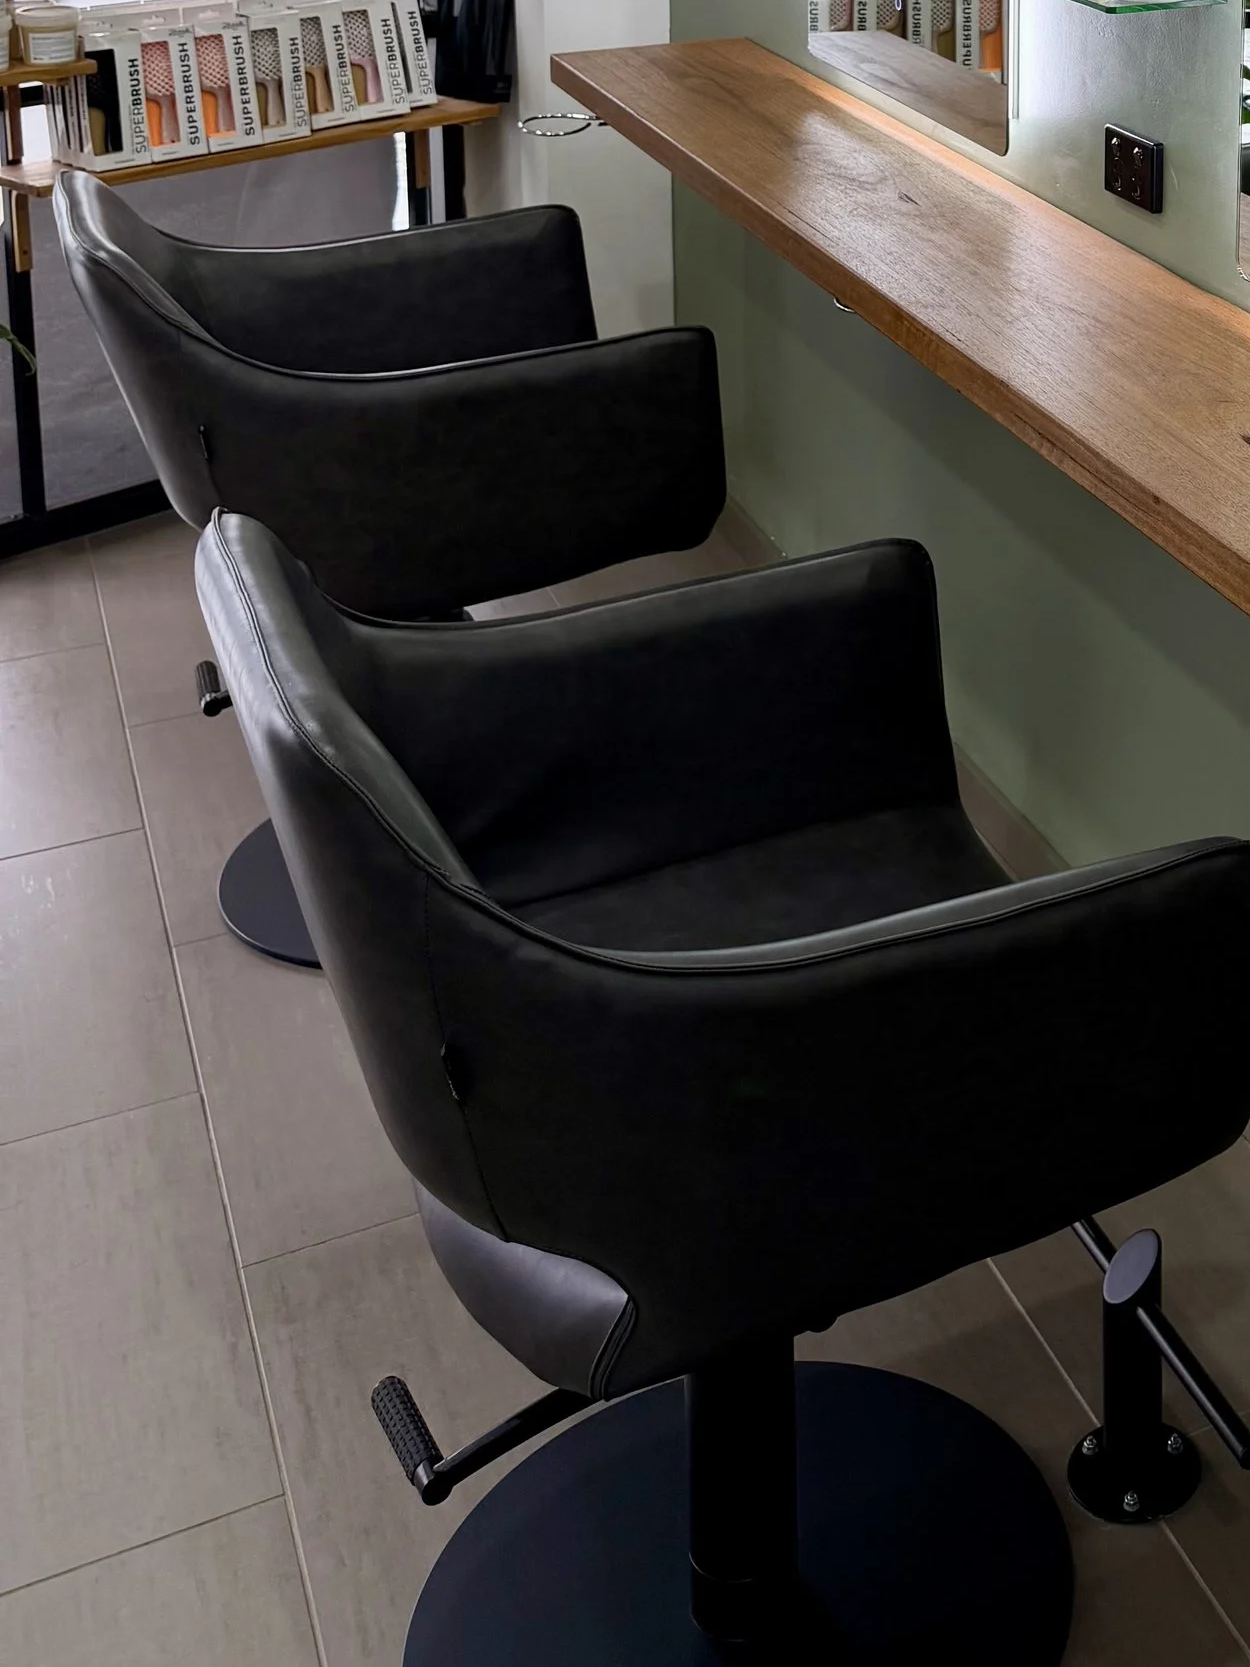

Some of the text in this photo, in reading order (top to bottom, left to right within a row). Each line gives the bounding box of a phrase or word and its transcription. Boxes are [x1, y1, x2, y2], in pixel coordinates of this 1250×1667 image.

[178, 42, 200, 145] SUPERBRUSH
[232, 35, 255, 136] SUPERBRUSH
[289, 37, 307, 127] SUPERBRUSH
[332, 25, 355, 112] SUPERBRUSH
[381, 18, 406, 104] SUPERBRUSH
[408, 11, 433, 94] SUPERBRUSH
[128, 58, 147, 153] SUPERBRUSH
